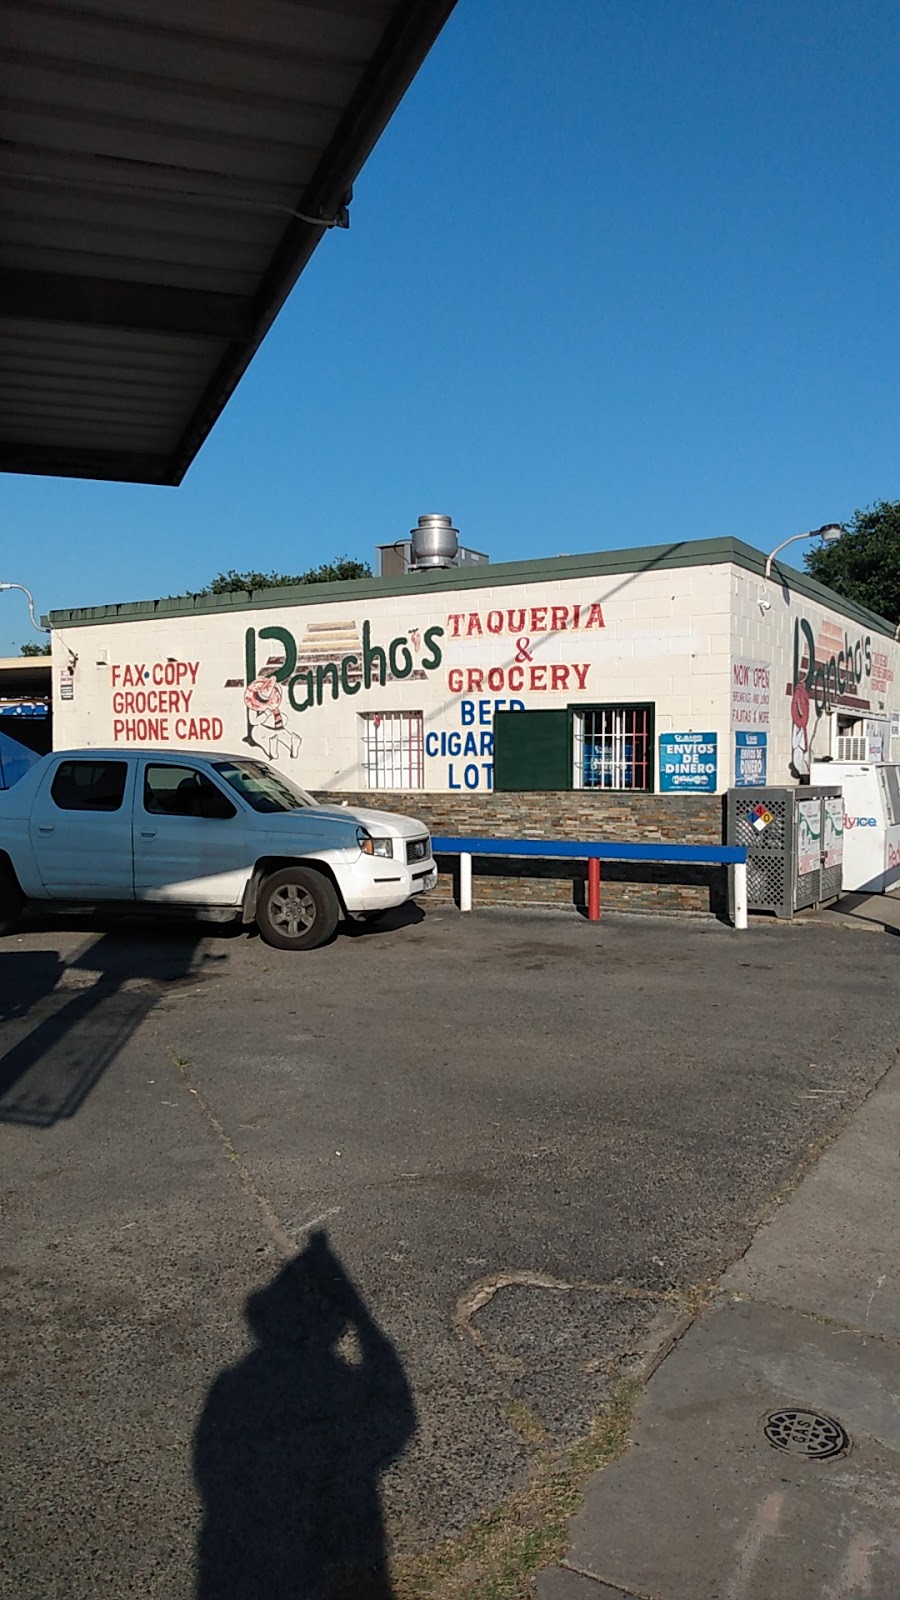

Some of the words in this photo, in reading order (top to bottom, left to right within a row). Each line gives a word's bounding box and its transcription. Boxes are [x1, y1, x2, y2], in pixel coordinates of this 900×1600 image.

[448, 603, 605, 637] TAQUERIA
[514, 637, 533, 663] &
[112, 664, 145, 687] FAX
[153, 662, 199, 685] COPY
[448, 664, 591, 693] GROCERY
[734, 664, 750, 686] NOW
[113, 690, 193, 714] GROCERY
[114, 718, 170, 742] PHONE
[175, 717, 223, 741] CARD
[665, 763, 715, 774] DINERO
[682, 754, 700, 763] DE
[792, 1420, 811, 1443] GAS
